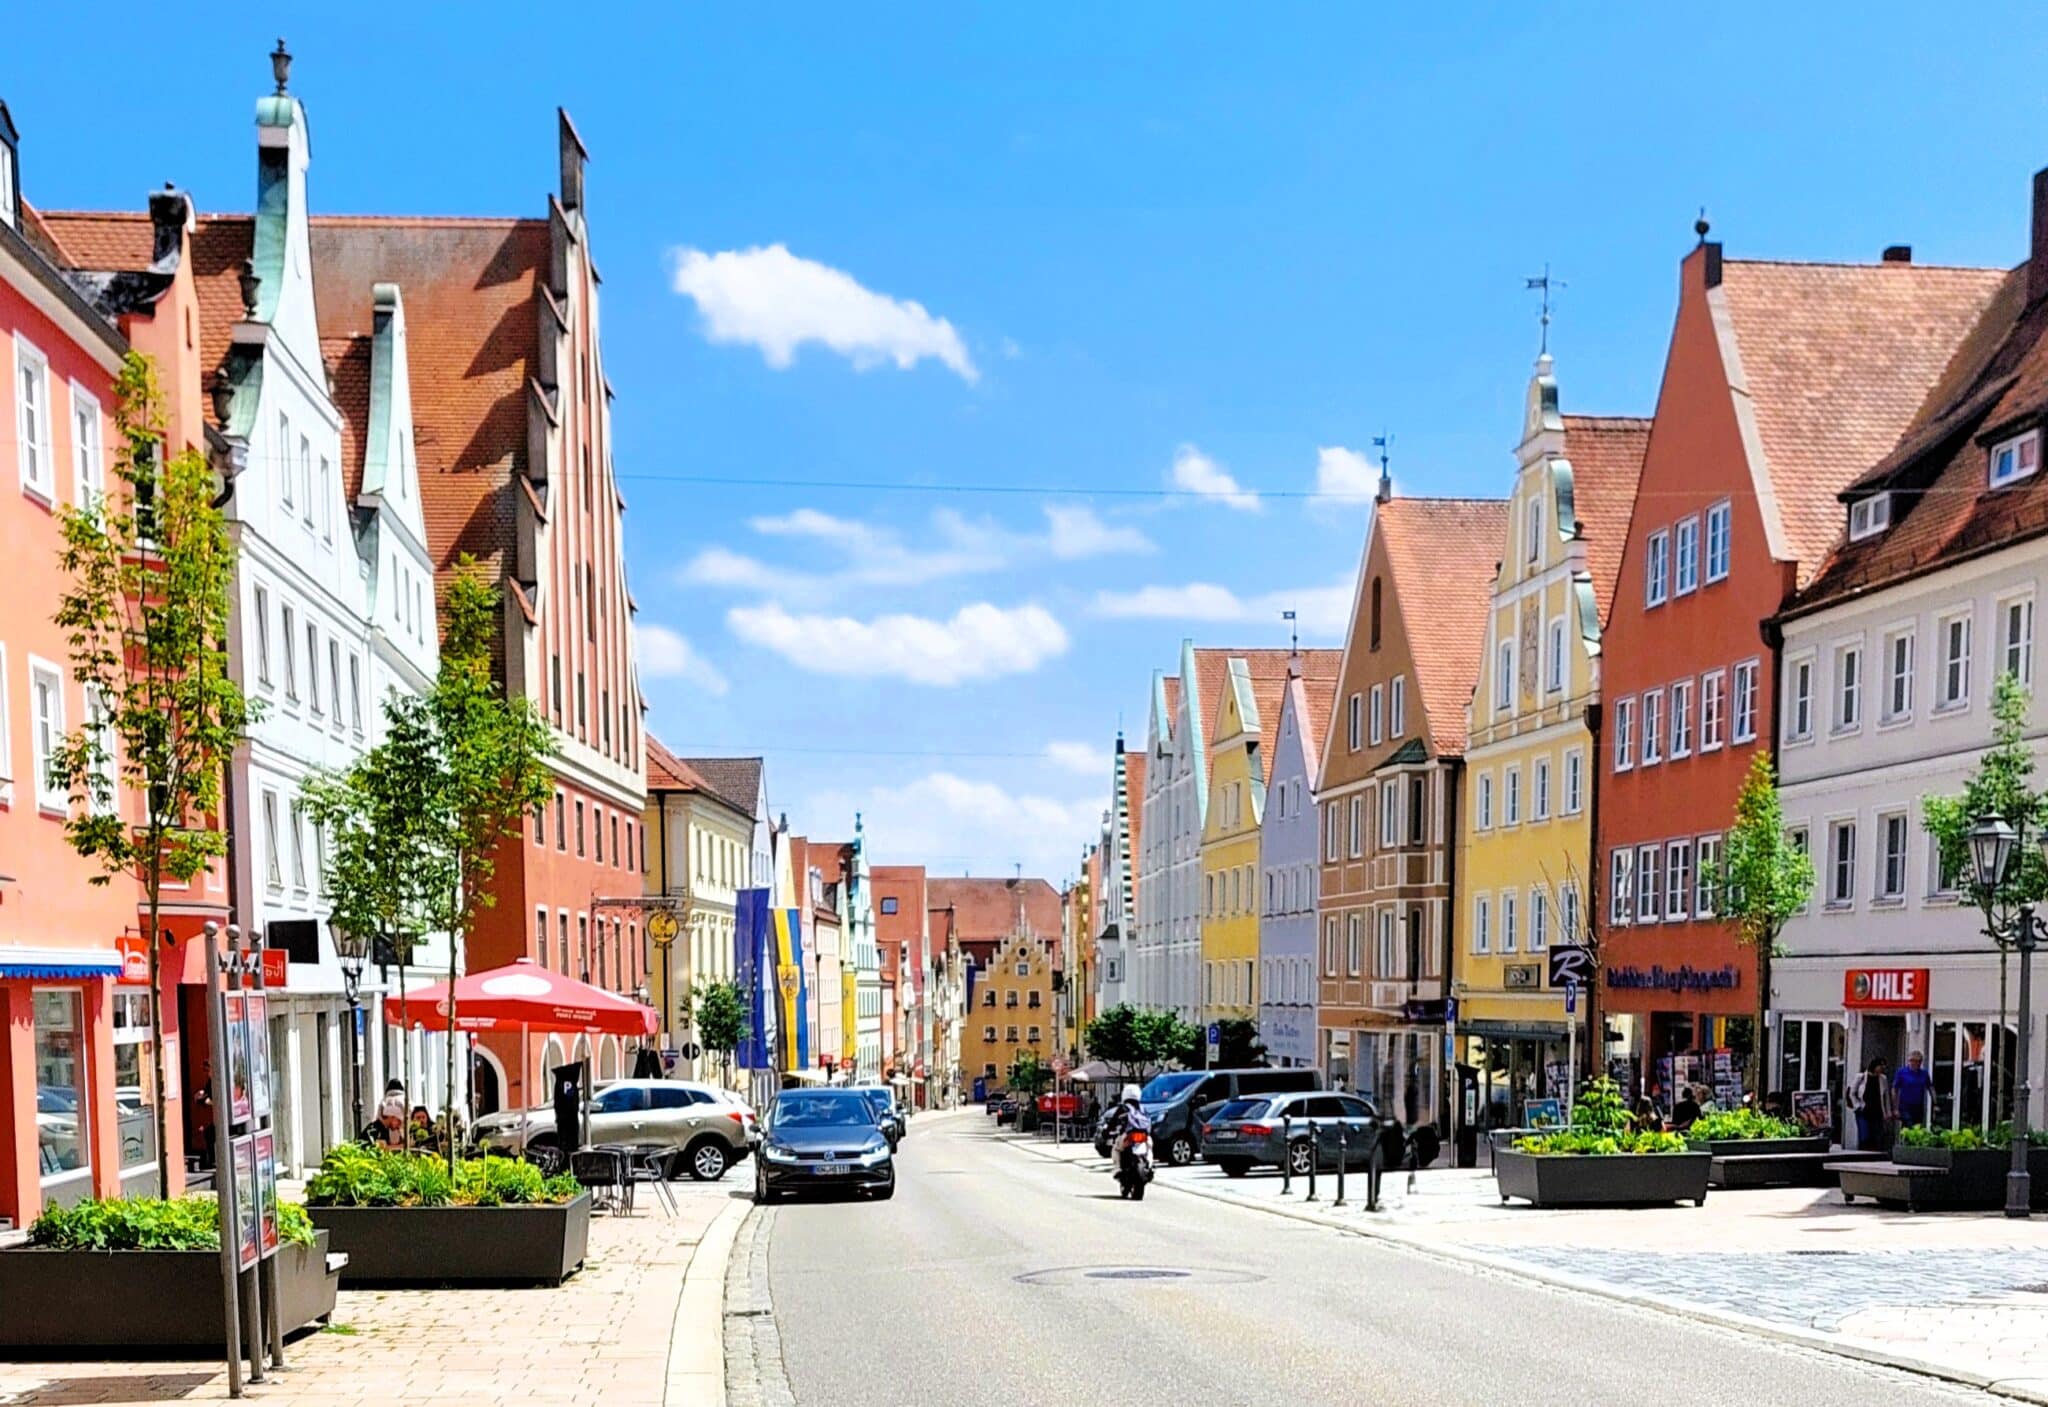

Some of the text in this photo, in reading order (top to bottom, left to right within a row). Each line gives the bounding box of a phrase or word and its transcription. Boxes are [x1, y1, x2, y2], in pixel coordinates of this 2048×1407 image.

[1871, 972, 1915, 1000] IHLE
[1568, 985, 1574, 1009] P
[1447, 999, 1454, 1018] P
[563, 1081, 572, 1094] P
